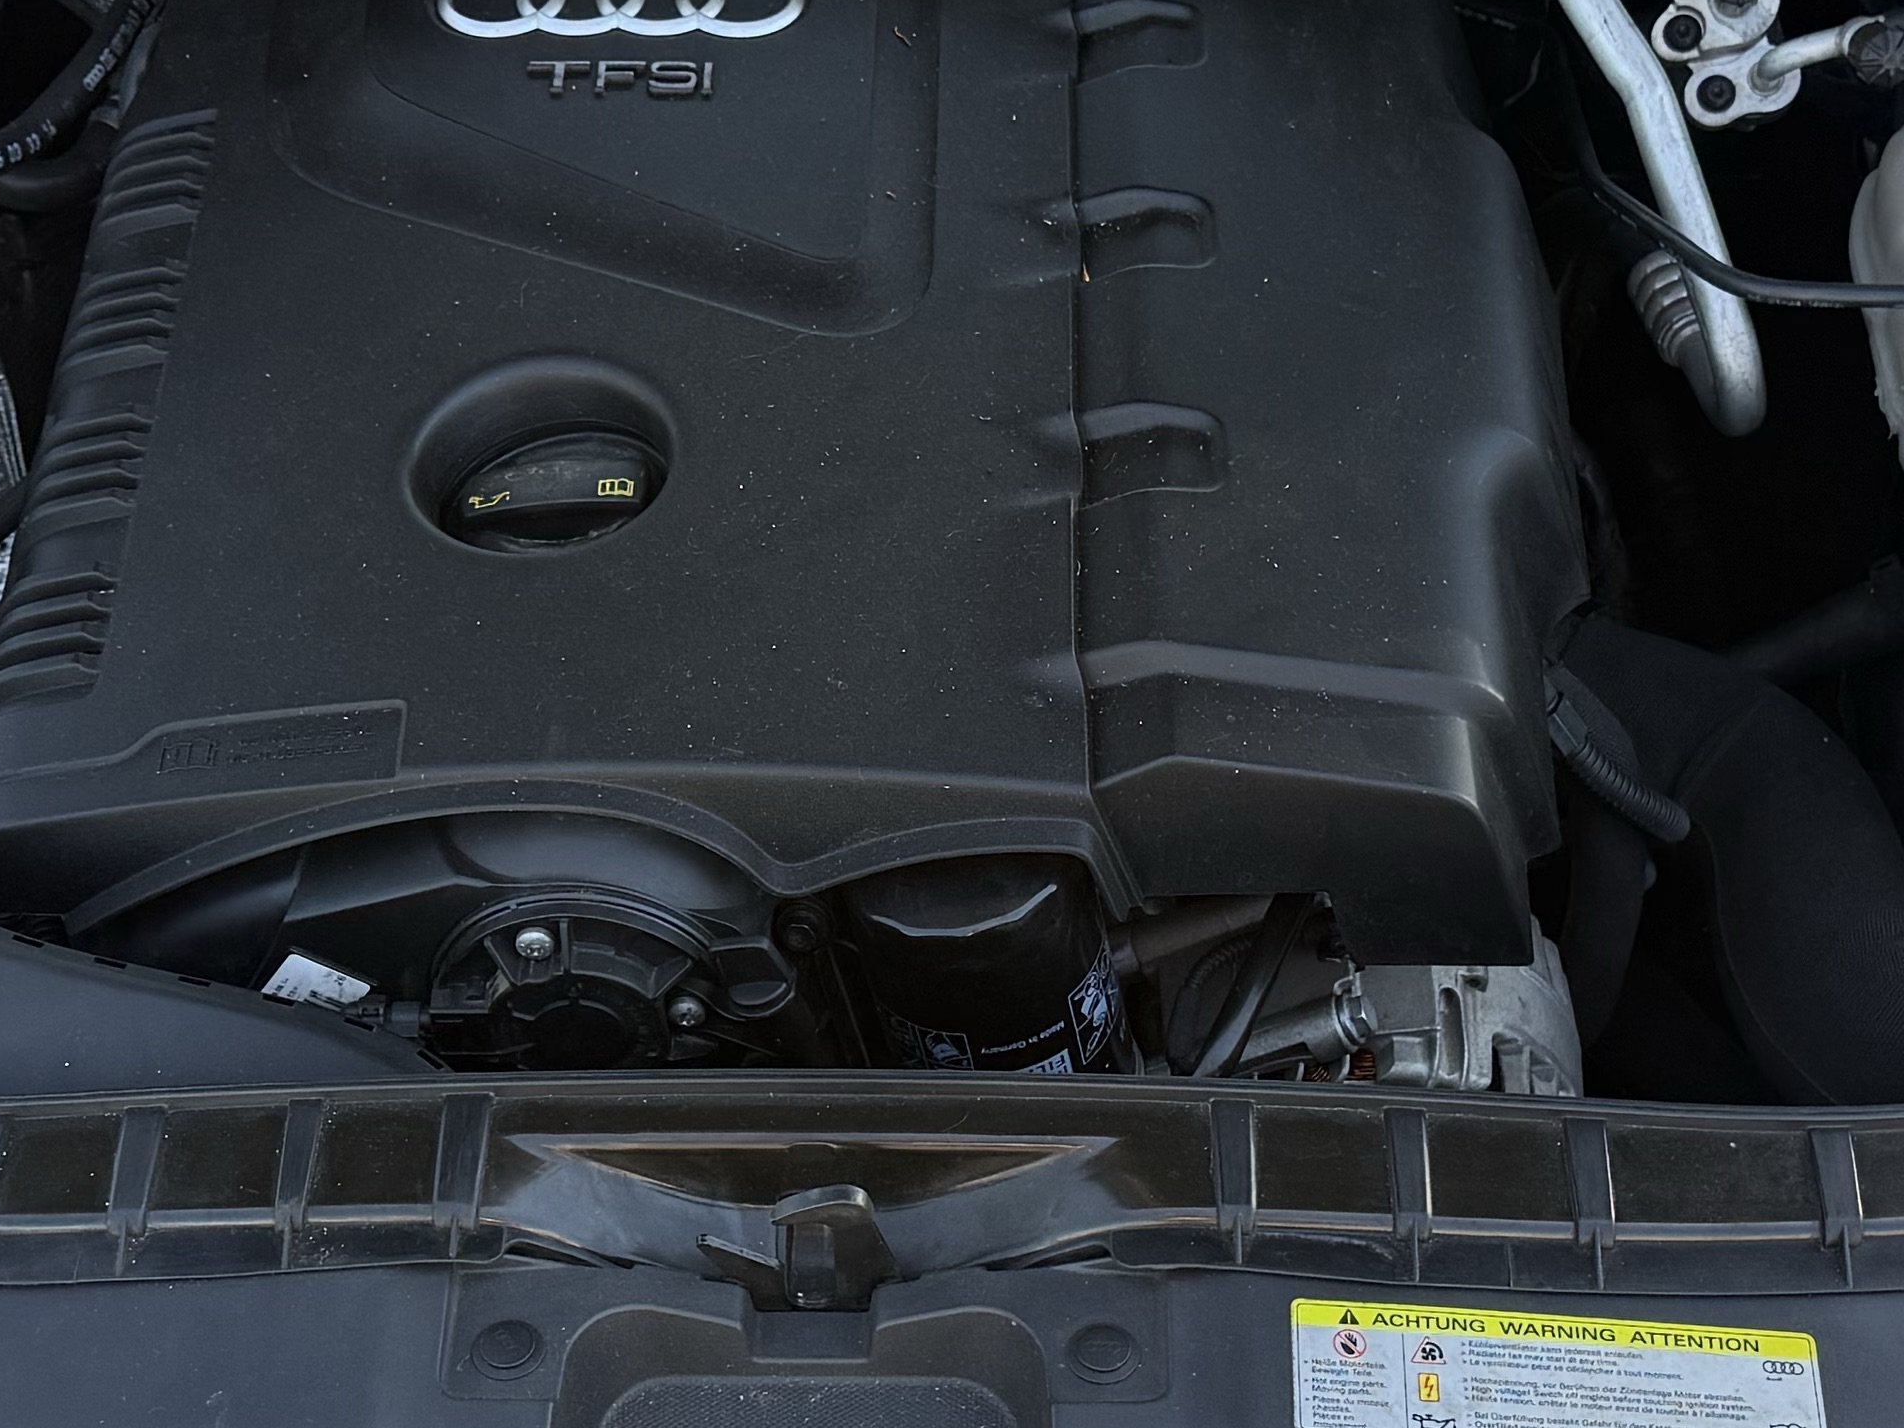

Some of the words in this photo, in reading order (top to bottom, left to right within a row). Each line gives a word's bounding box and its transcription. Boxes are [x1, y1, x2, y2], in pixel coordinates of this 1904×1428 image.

[527, 61, 713, 96] TFSI
[1039, 1020, 1065, 1039] Made
[1372, 1313, 1486, 1334] ACHTUNG
[1499, 1321, 1616, 1342] WARNING
[1630, 1330, 1760, 1353] ATTENTION
